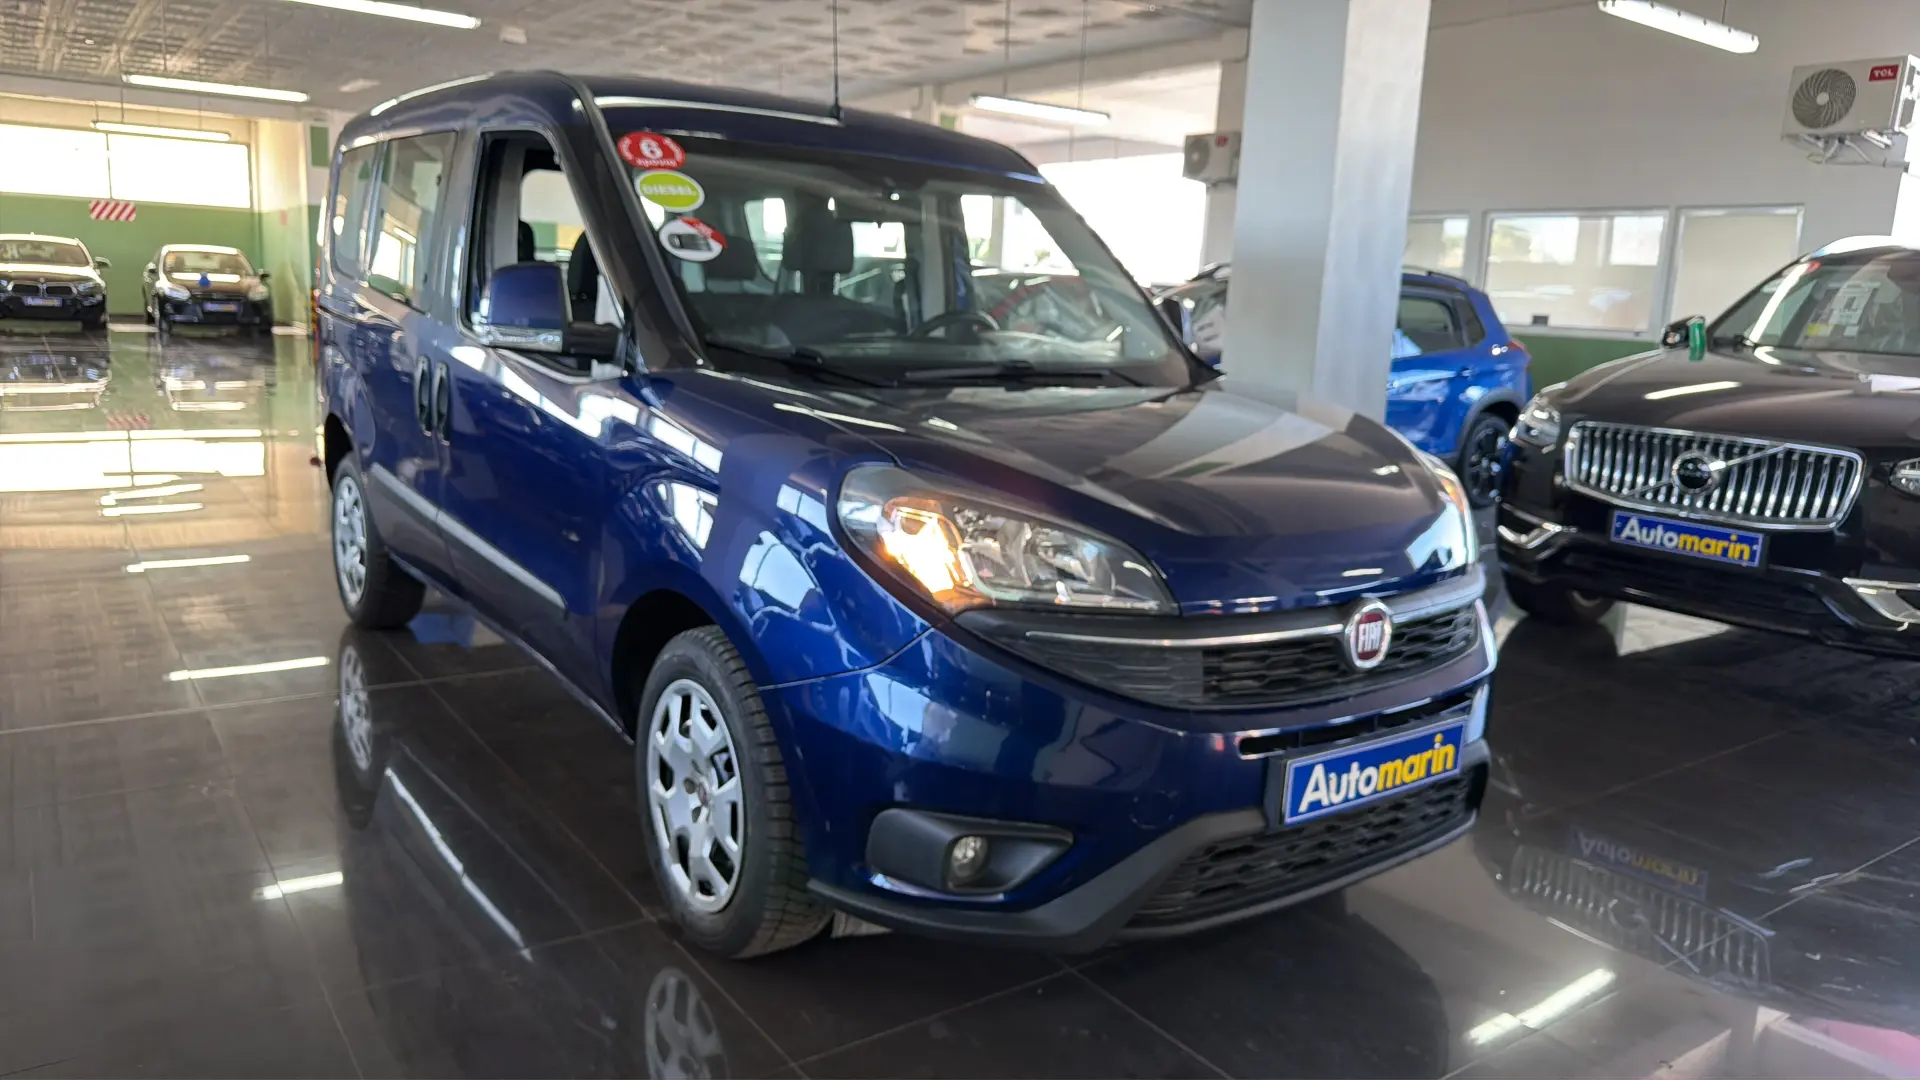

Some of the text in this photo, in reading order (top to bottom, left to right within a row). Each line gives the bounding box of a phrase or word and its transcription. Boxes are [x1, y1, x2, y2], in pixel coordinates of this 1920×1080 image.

[1873, 68, 1893, 78] TCL
[640, 137, 663, 160] 6
[642, 184, 697, 197] DIESEL
[1620, 516, 1750, 561] Automarin
[1357, 621, 1382, 653] FIAT
[1298, 733, 1455, 813] Automarin
